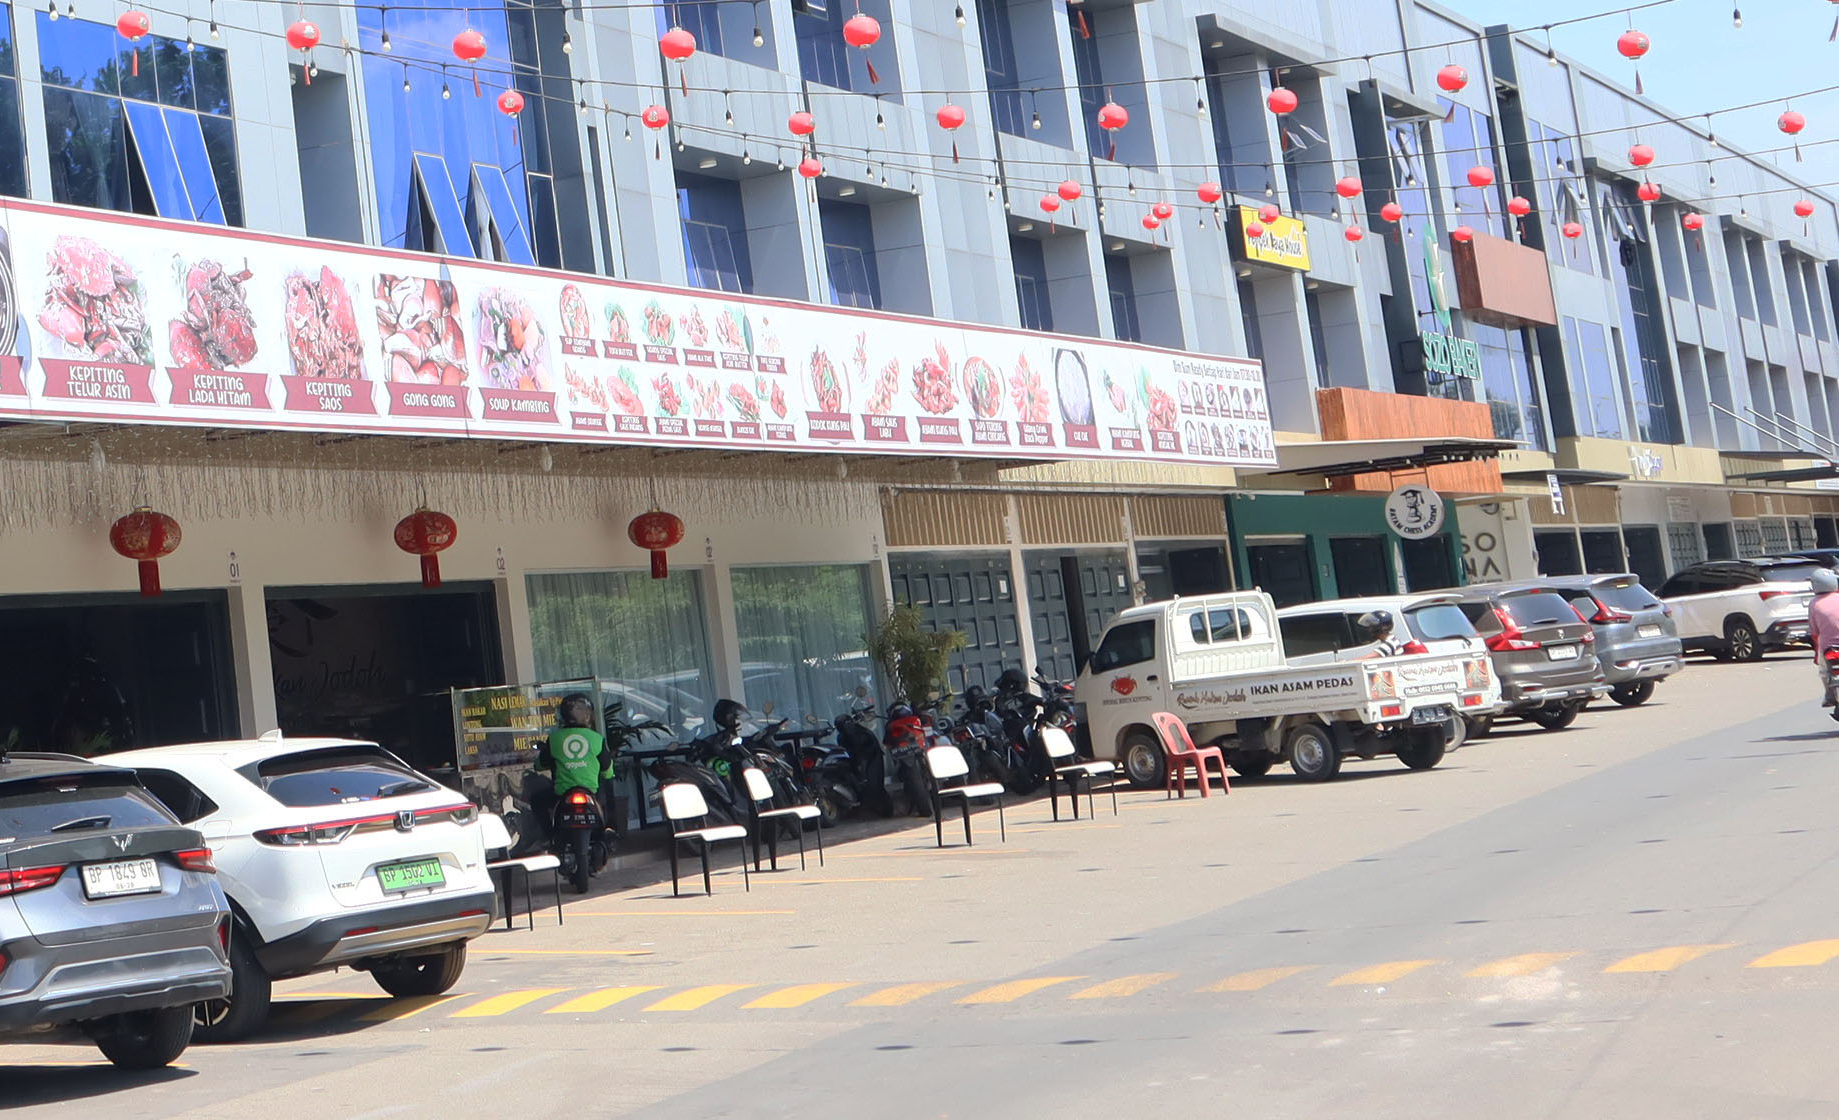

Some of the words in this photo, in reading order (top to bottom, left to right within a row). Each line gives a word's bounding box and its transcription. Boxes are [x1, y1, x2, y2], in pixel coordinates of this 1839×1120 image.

[1422, 330, 1451, 375] SOZO
[69, 365, 125, 383] KEPITING
[193, 374, 244, 391] KEPITING
[67, 381, 103, 398] TELUR
[105, 383, 131, 400] ASIN
[189, 388, 215, 404] LADA
[217, 390, 252, 407] HITAM
[305, 382, 352, 397] KEPITING
[319, 396, 343, 411] SAOS
[403, 392, 428, 407] GONG
[431, 394, 456, 409] GONG
[489, 397, 510, 411] SOUP
[510, 398, 550, 414] KAMBING
[1389, 508, 1403, 530] BATAM
[1404, 526, 1423, 534] CHESS
[229, 563, 240, 578] 01
[1250, 684, 1280, 696] IKAN
[1282, 681, 1314, 692] ASAM
[1316, 677, 1354, 690] PEDAS
[491, 696, 508, 711] NASI
[543, 714, 557, 727] MIE
[514, 736, 527, 751] MIE
[565, 761, 588, 770] gojek
[88, 865, 103, 884] BP
[110, 862, 137, 882] 1849
[383, 867, 396, 883] BP
